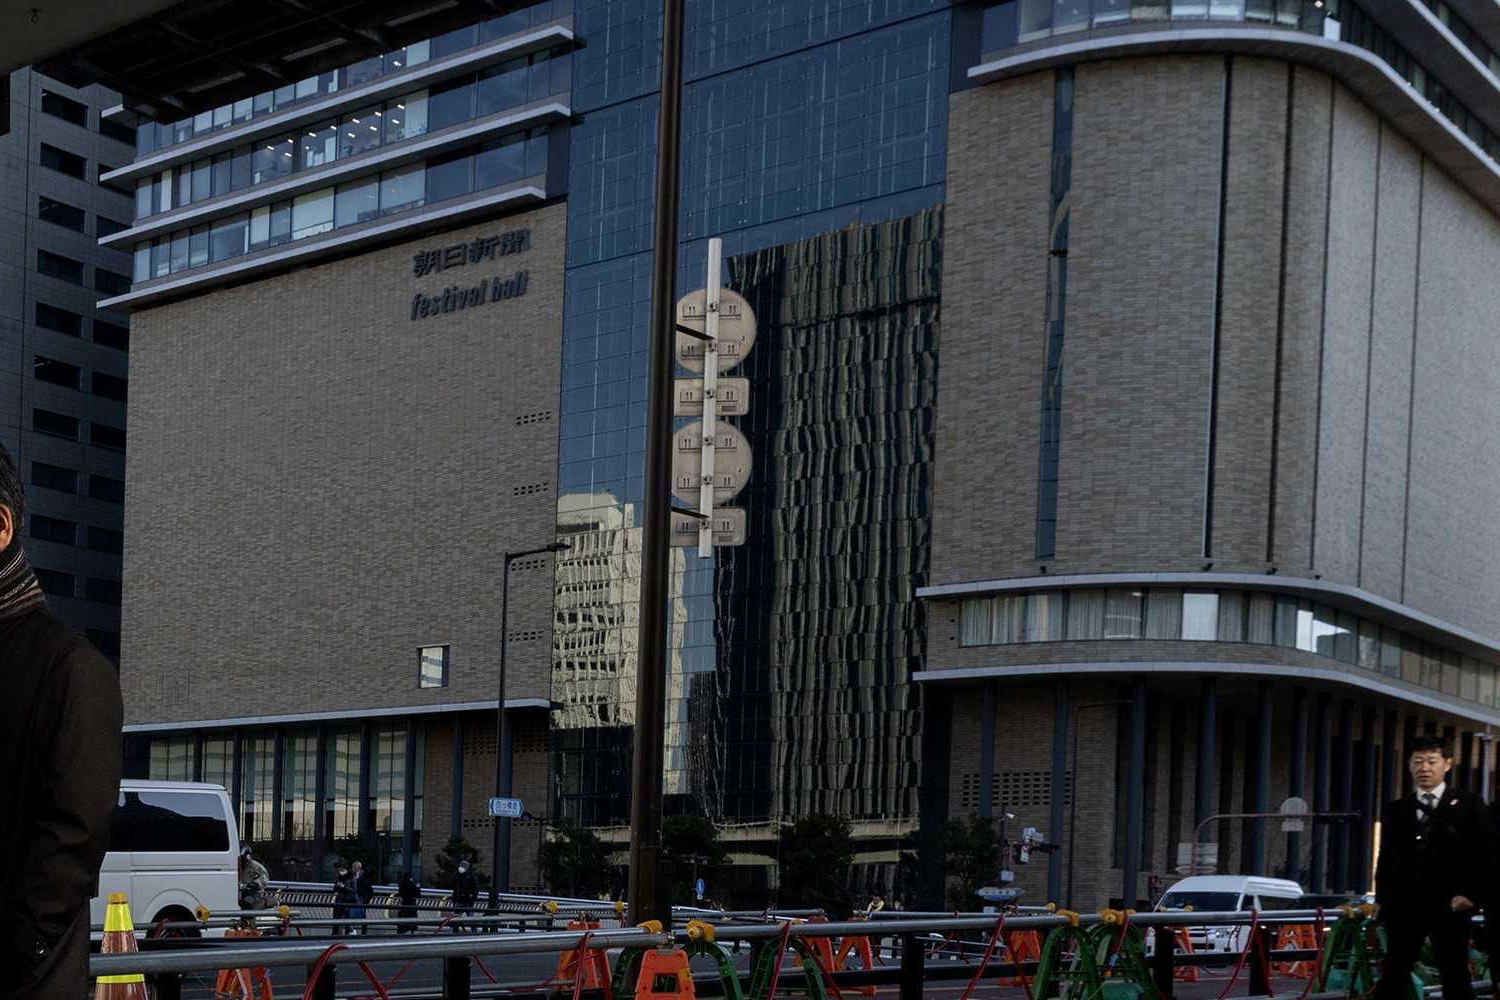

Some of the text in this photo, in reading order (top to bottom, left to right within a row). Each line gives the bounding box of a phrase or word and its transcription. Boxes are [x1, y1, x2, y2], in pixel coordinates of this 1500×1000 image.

[412, 227, 530, 278] 朝日新聞
[411, 269, 529, 321] festival hall
